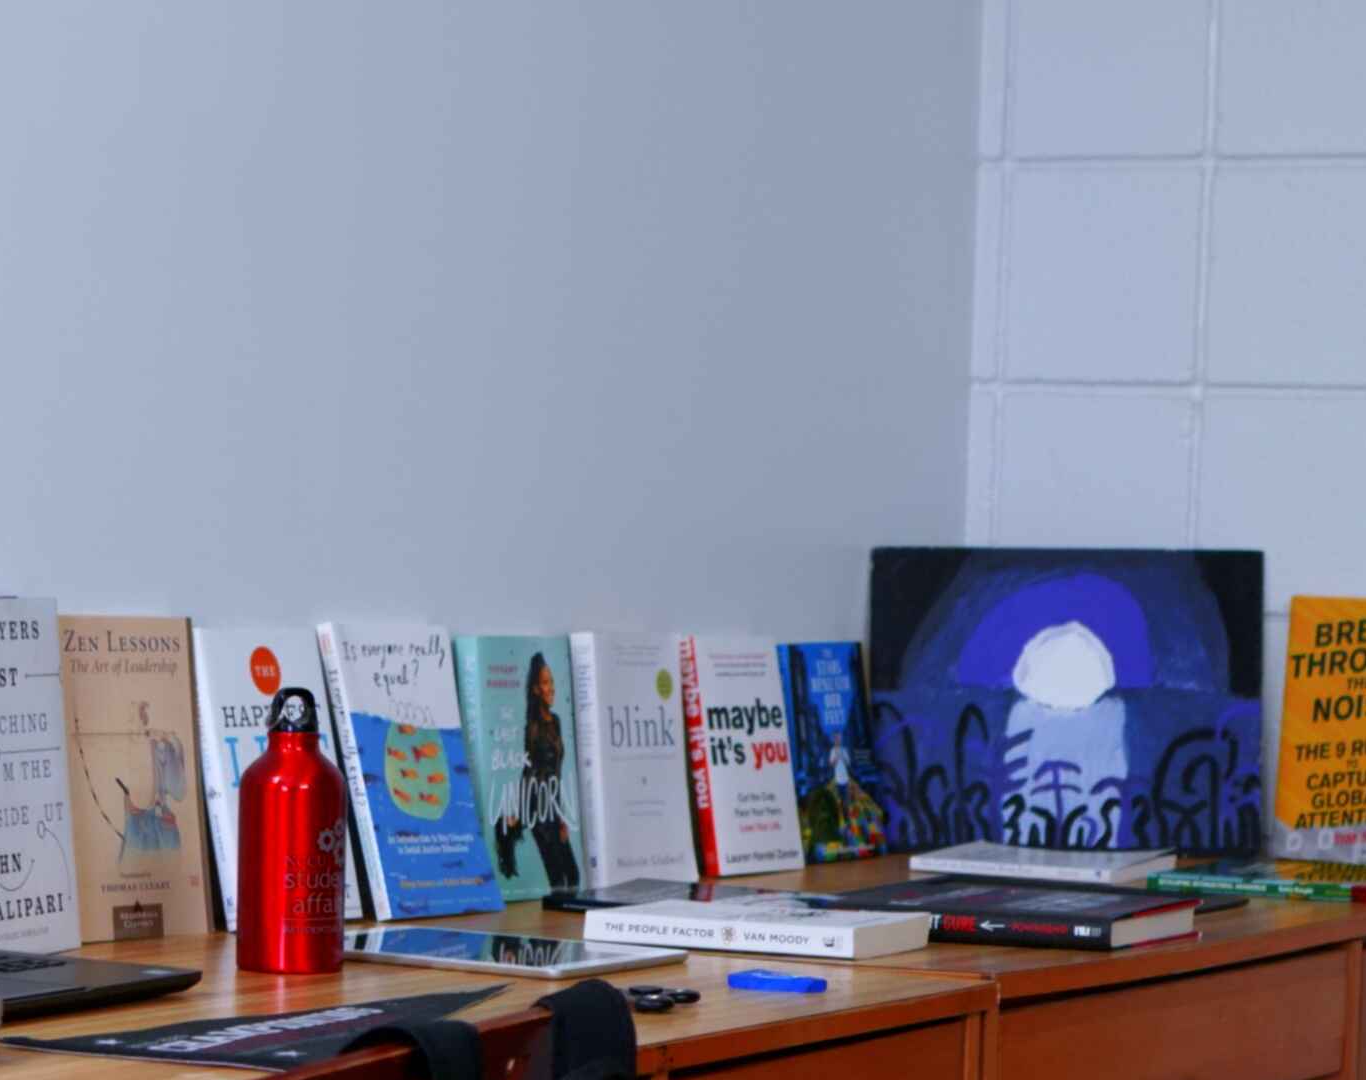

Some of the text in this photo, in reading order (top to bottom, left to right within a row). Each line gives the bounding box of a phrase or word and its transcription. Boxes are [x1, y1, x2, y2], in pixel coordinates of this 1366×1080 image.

[69, 658, 178, 678] The Art of Leadership
[342, 634, 445, 670] Is everyone really
[373, 658, 420, 697] equal?
[607, 705, 676, 748] blink
[680, 639, 711, 809] maybe it's you
[707, 697, 783, 736] maybe
[491, 750, 532, 771] BLACK
[710, 736, 788, 771] it's you
[1295, 743, 1329, 761] THE
[1336, 741, 1346, 759] 9
[21, 759, 52, 780] THE
[489, 772, 579, 837] UNICORN
[604, 921, 810, 946] THE PEOPLE FACTOR VAN MOODY
